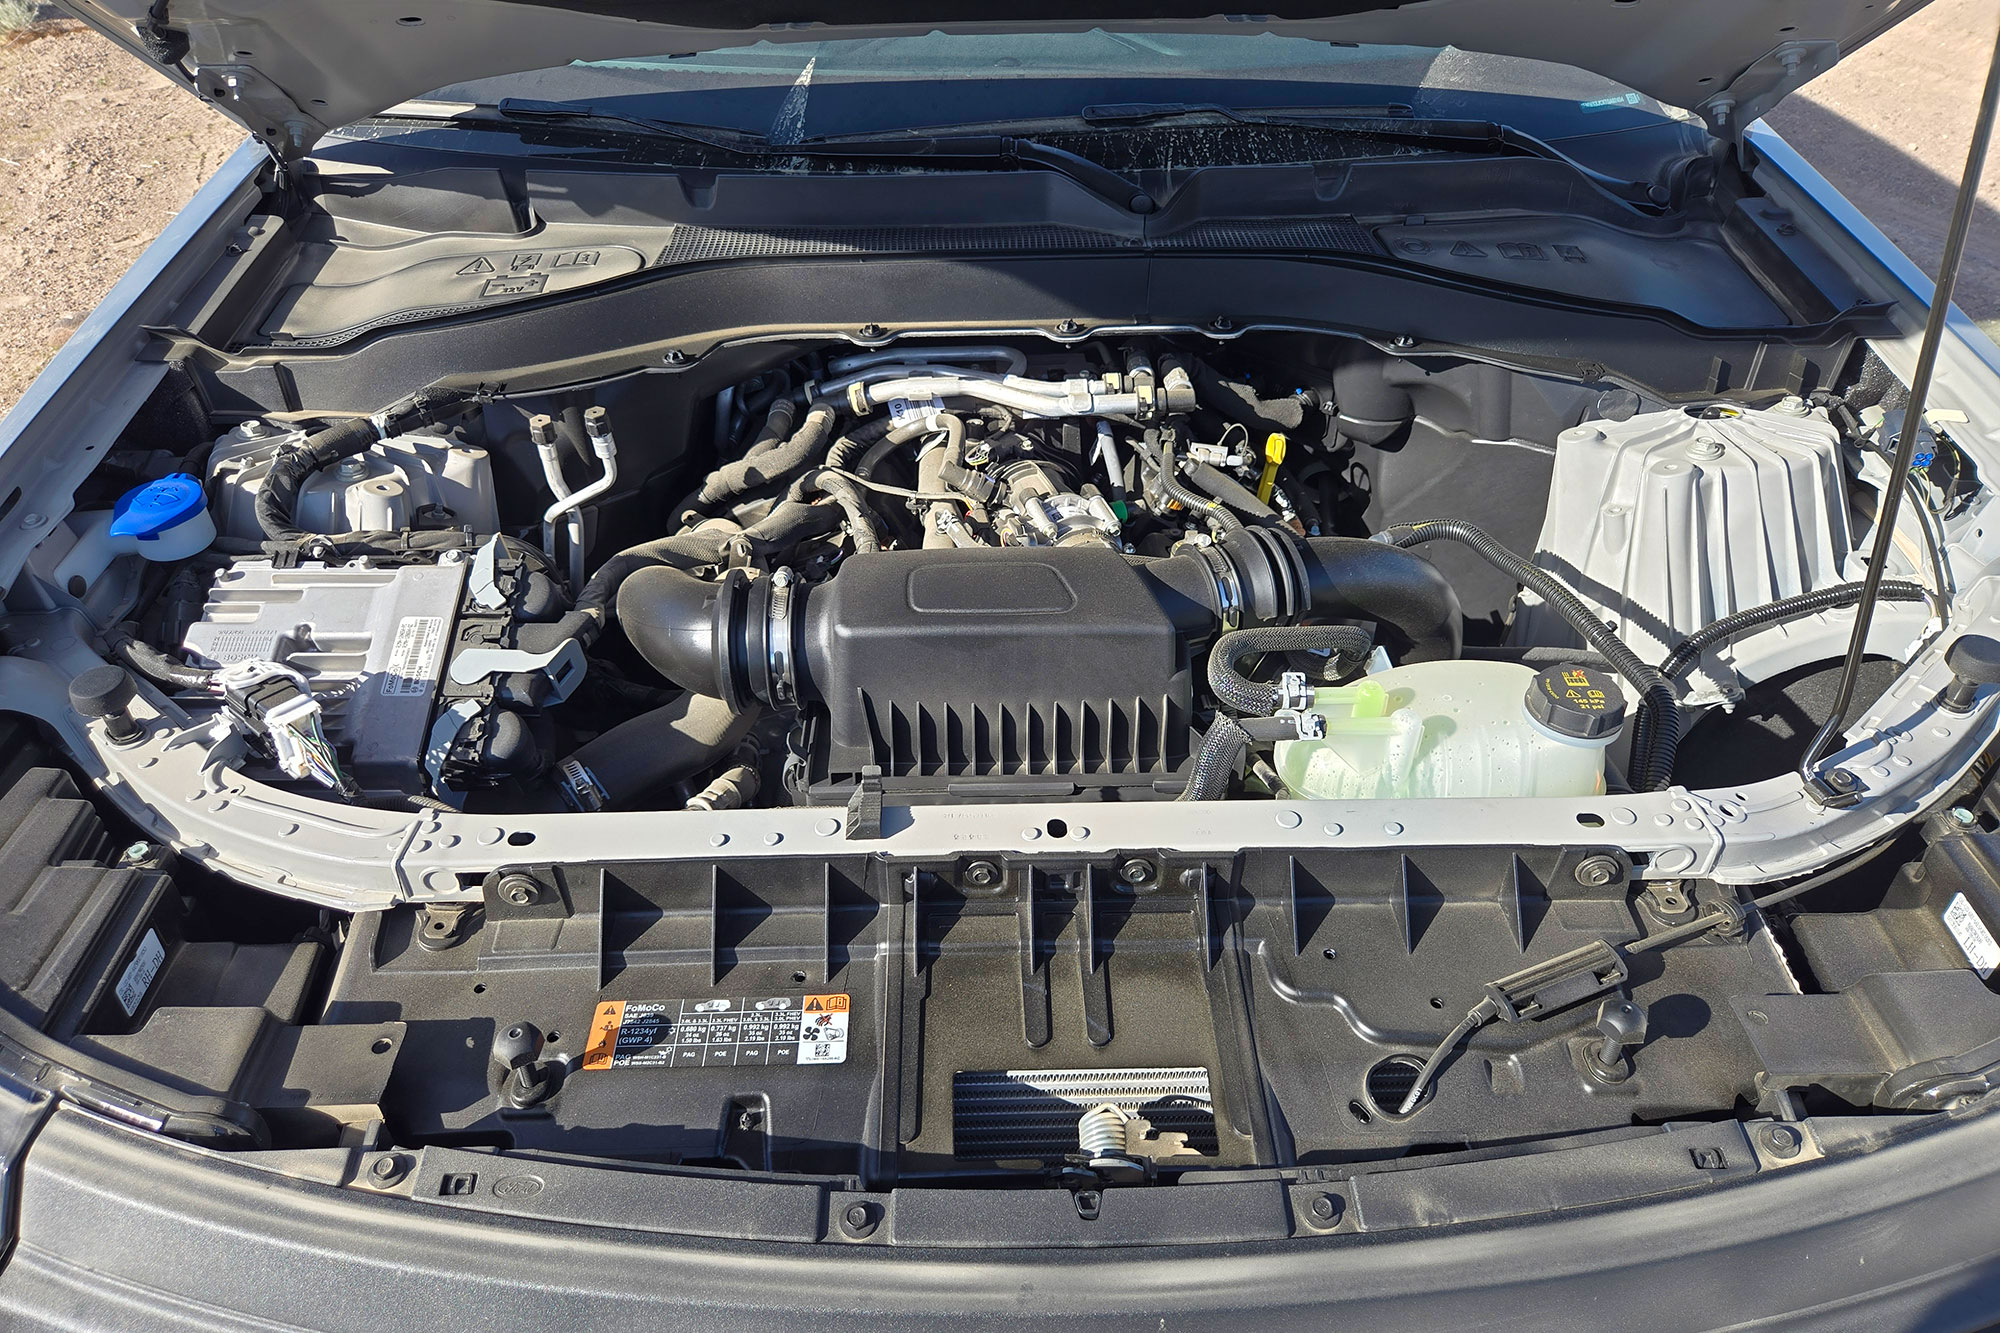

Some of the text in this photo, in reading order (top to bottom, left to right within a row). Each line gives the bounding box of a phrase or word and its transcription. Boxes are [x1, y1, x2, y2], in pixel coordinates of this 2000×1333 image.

[894, 403, 905, 420] X10
[386, 667, 399, 693] FoMoCo
[414, 665, 423, 685] BOSCH
[141, 950, 163, 988] RH-DH
[625, 1003, 665, 1012] FoMoCo
[620, 1027, 658, 1036] R-1234yf
[697, 1025, 707, 1033] kg
[761, 1023, 769, 1031] kg
[618, 1036, 653, 1045] (GWP 4)
[497, 1178, 540, 1193] Ford
